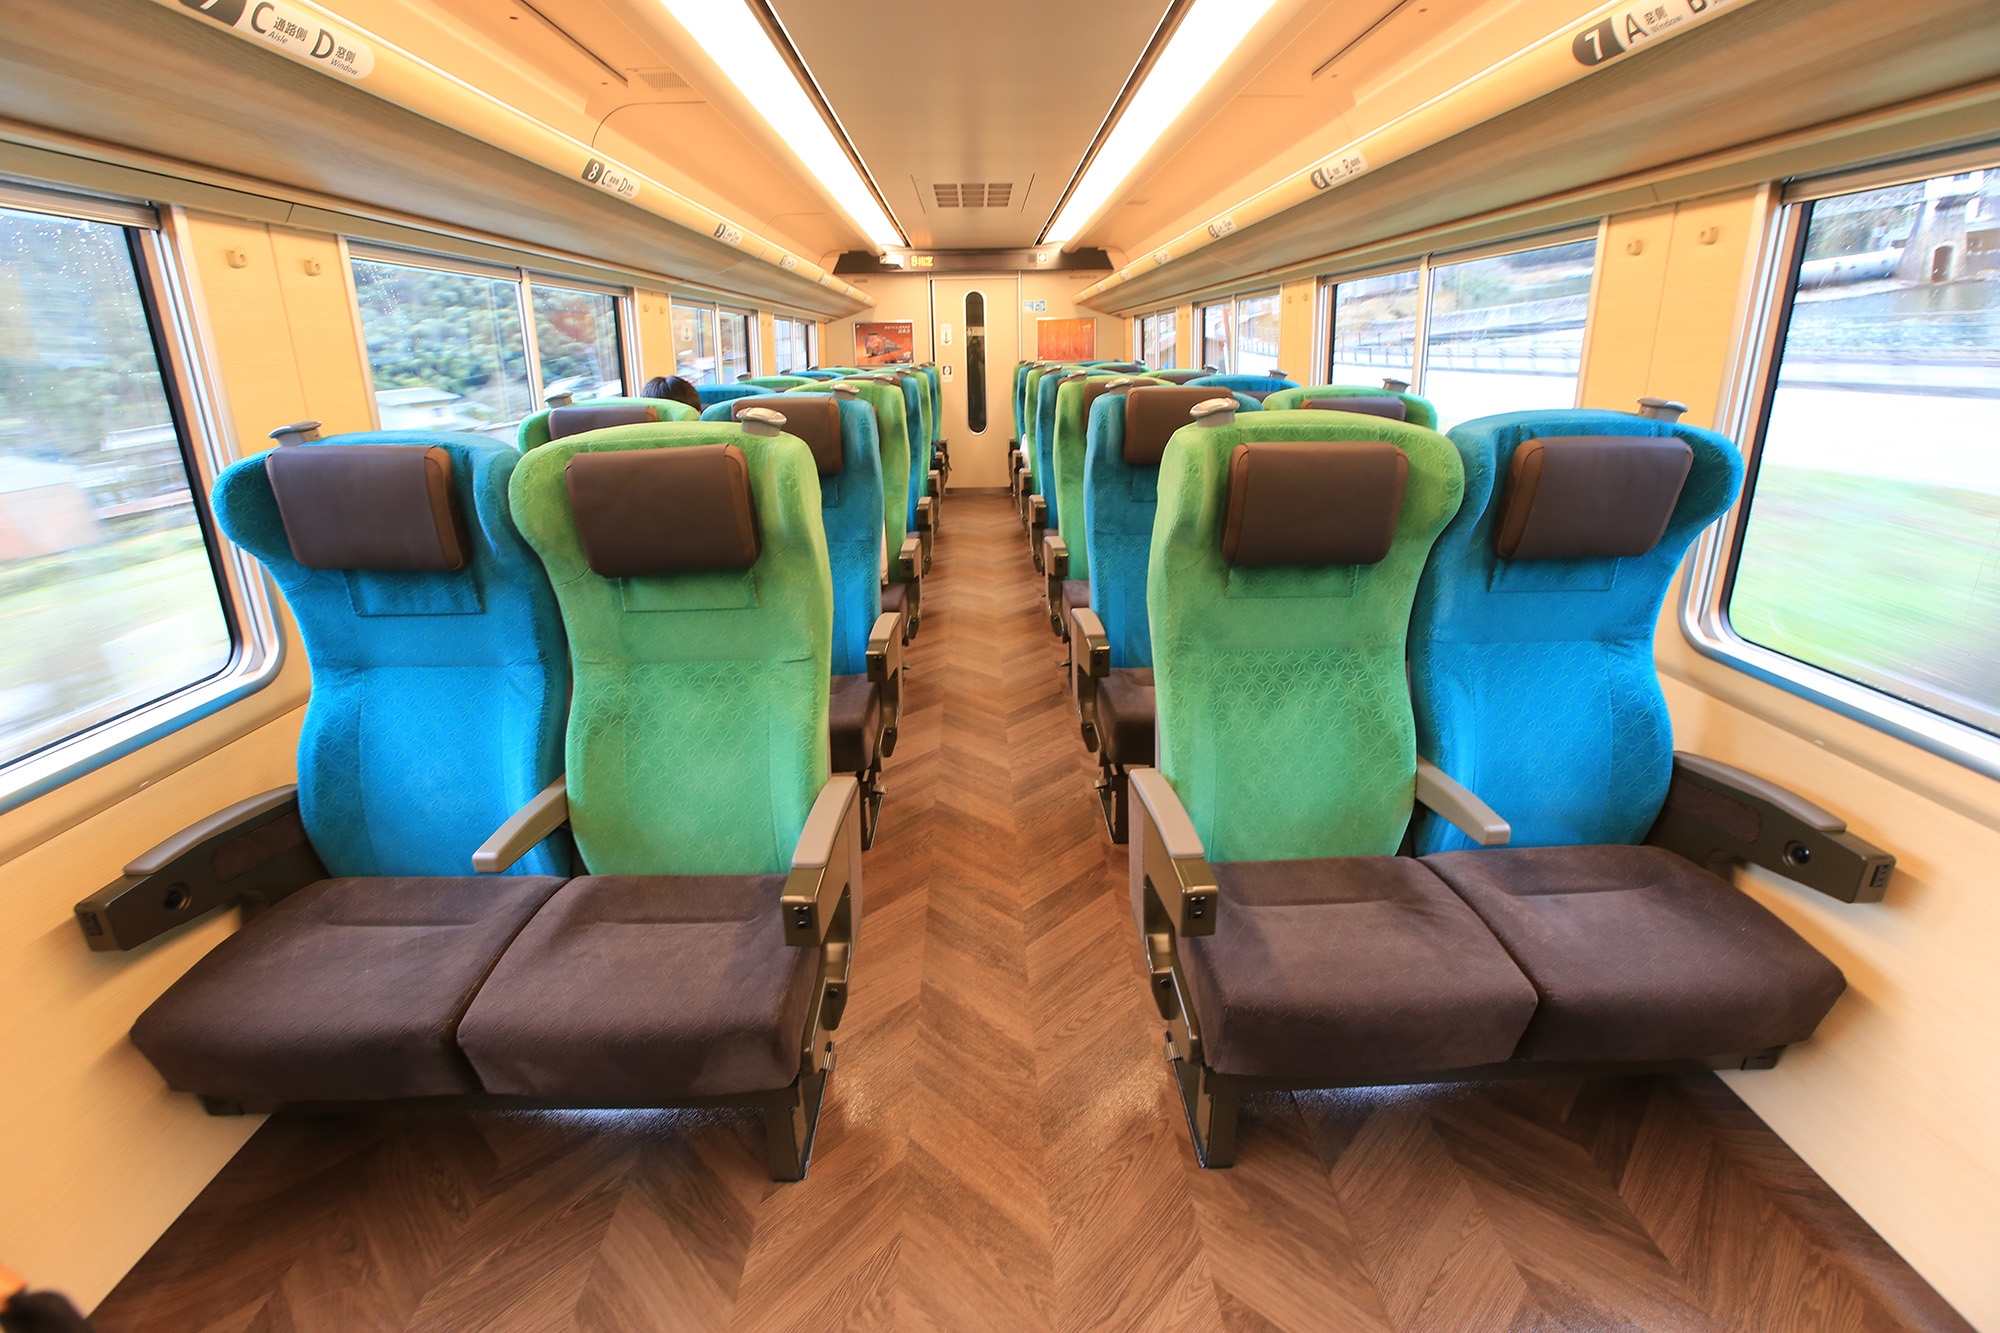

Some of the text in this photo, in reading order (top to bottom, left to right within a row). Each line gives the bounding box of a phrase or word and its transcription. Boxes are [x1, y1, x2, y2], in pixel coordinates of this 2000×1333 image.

[250, 1, 275, 35] C
[272, 16, 308, 42] 通路側
[267, 30, 289, 45] Aisle
[310, 28, 335, 59] D
[1583, 13, 1649, 61] 7 A
[330, 58, 359, 76] Window
[335, 46, 357, 64] 窓側
[587, 161, 600, 182] 8
[601, 169, 612, 185] C
[616, 177, 629, 193] D
[1313, 170, 1326, 189] 8
